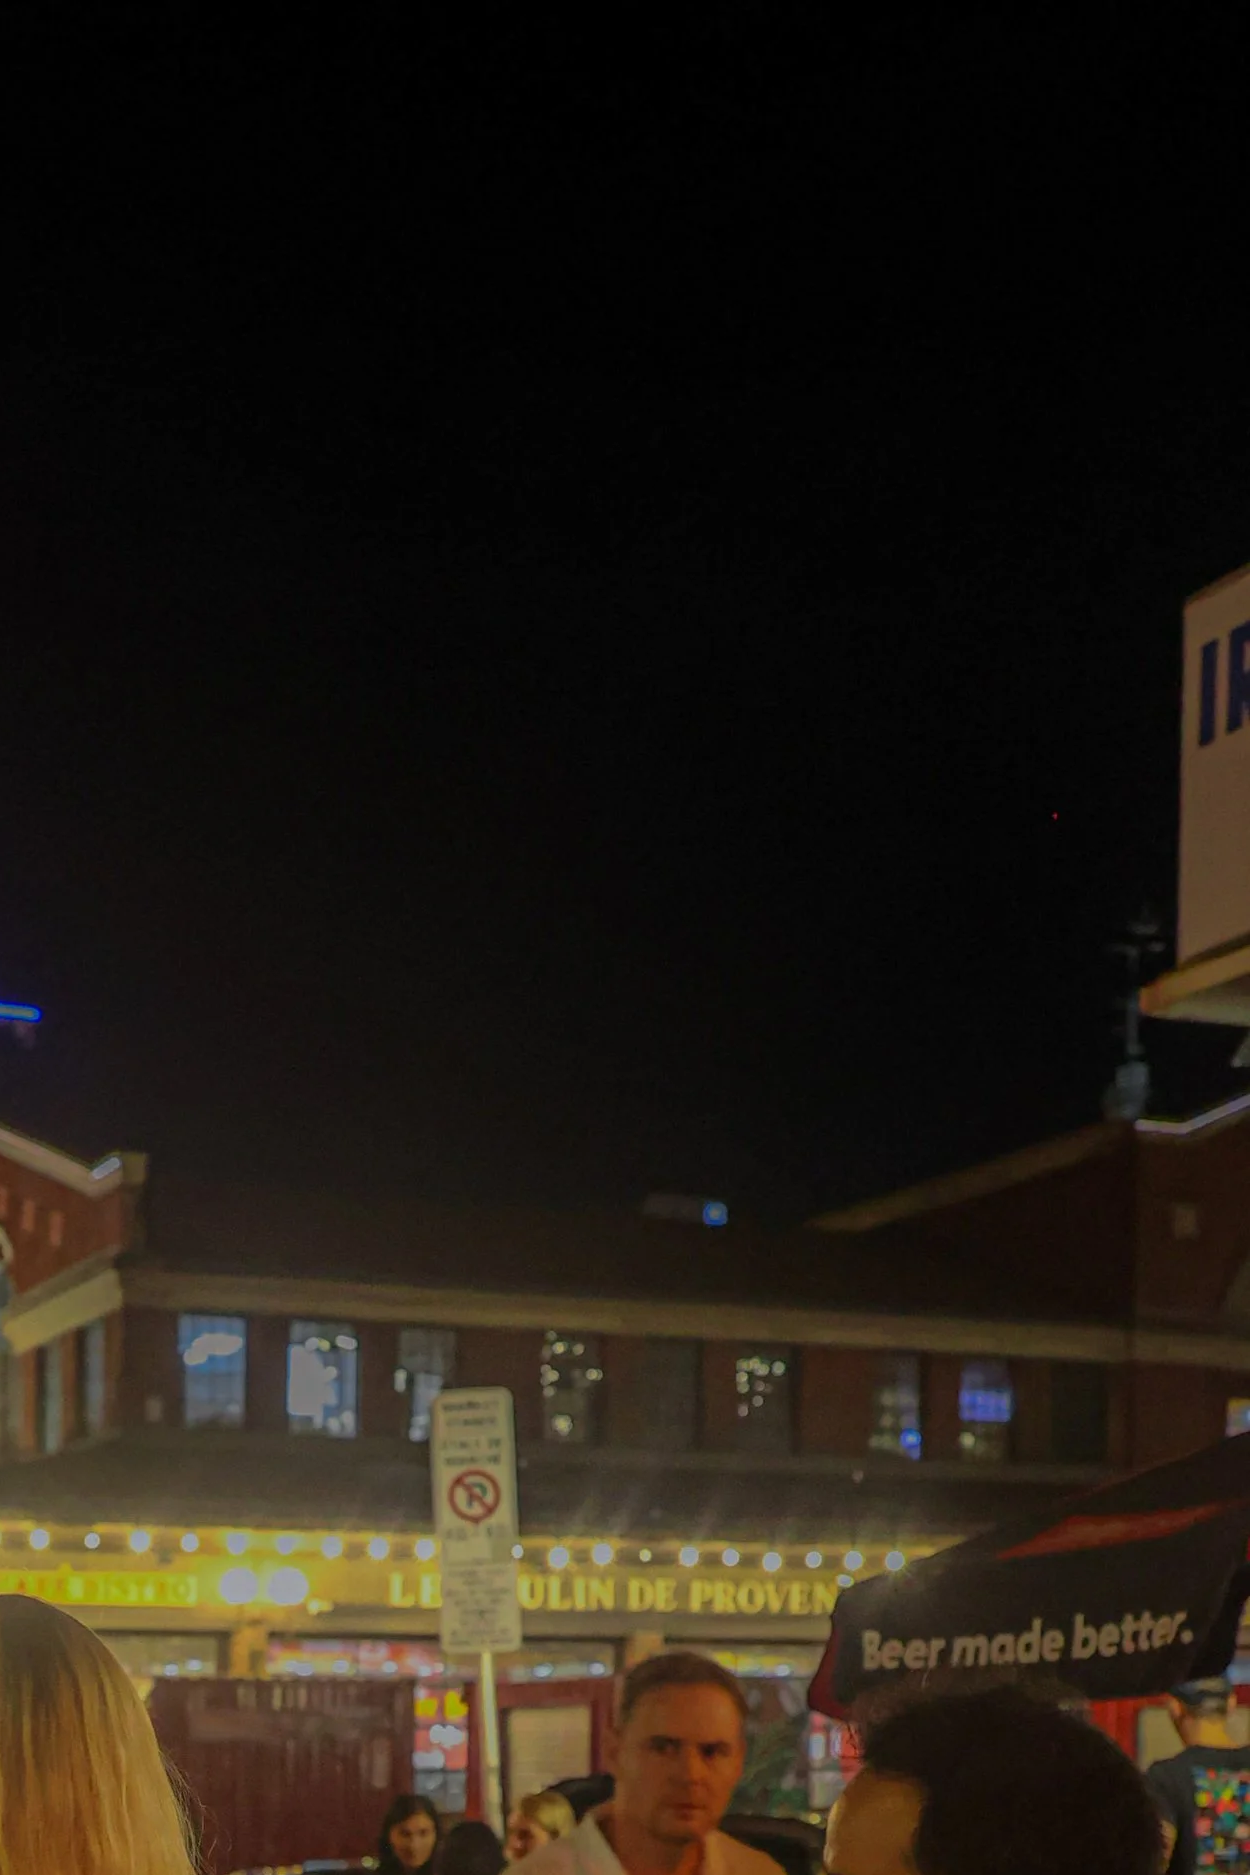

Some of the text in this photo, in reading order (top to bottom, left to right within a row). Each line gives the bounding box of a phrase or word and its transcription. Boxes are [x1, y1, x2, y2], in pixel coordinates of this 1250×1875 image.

[516, 1572, 615, 1611] ULIN
[626, 1576, 678, 1613] DE
[690, 1578, 838, 1616] PROVEN
[861, 1610, 1194, 1671] Beer made better.
